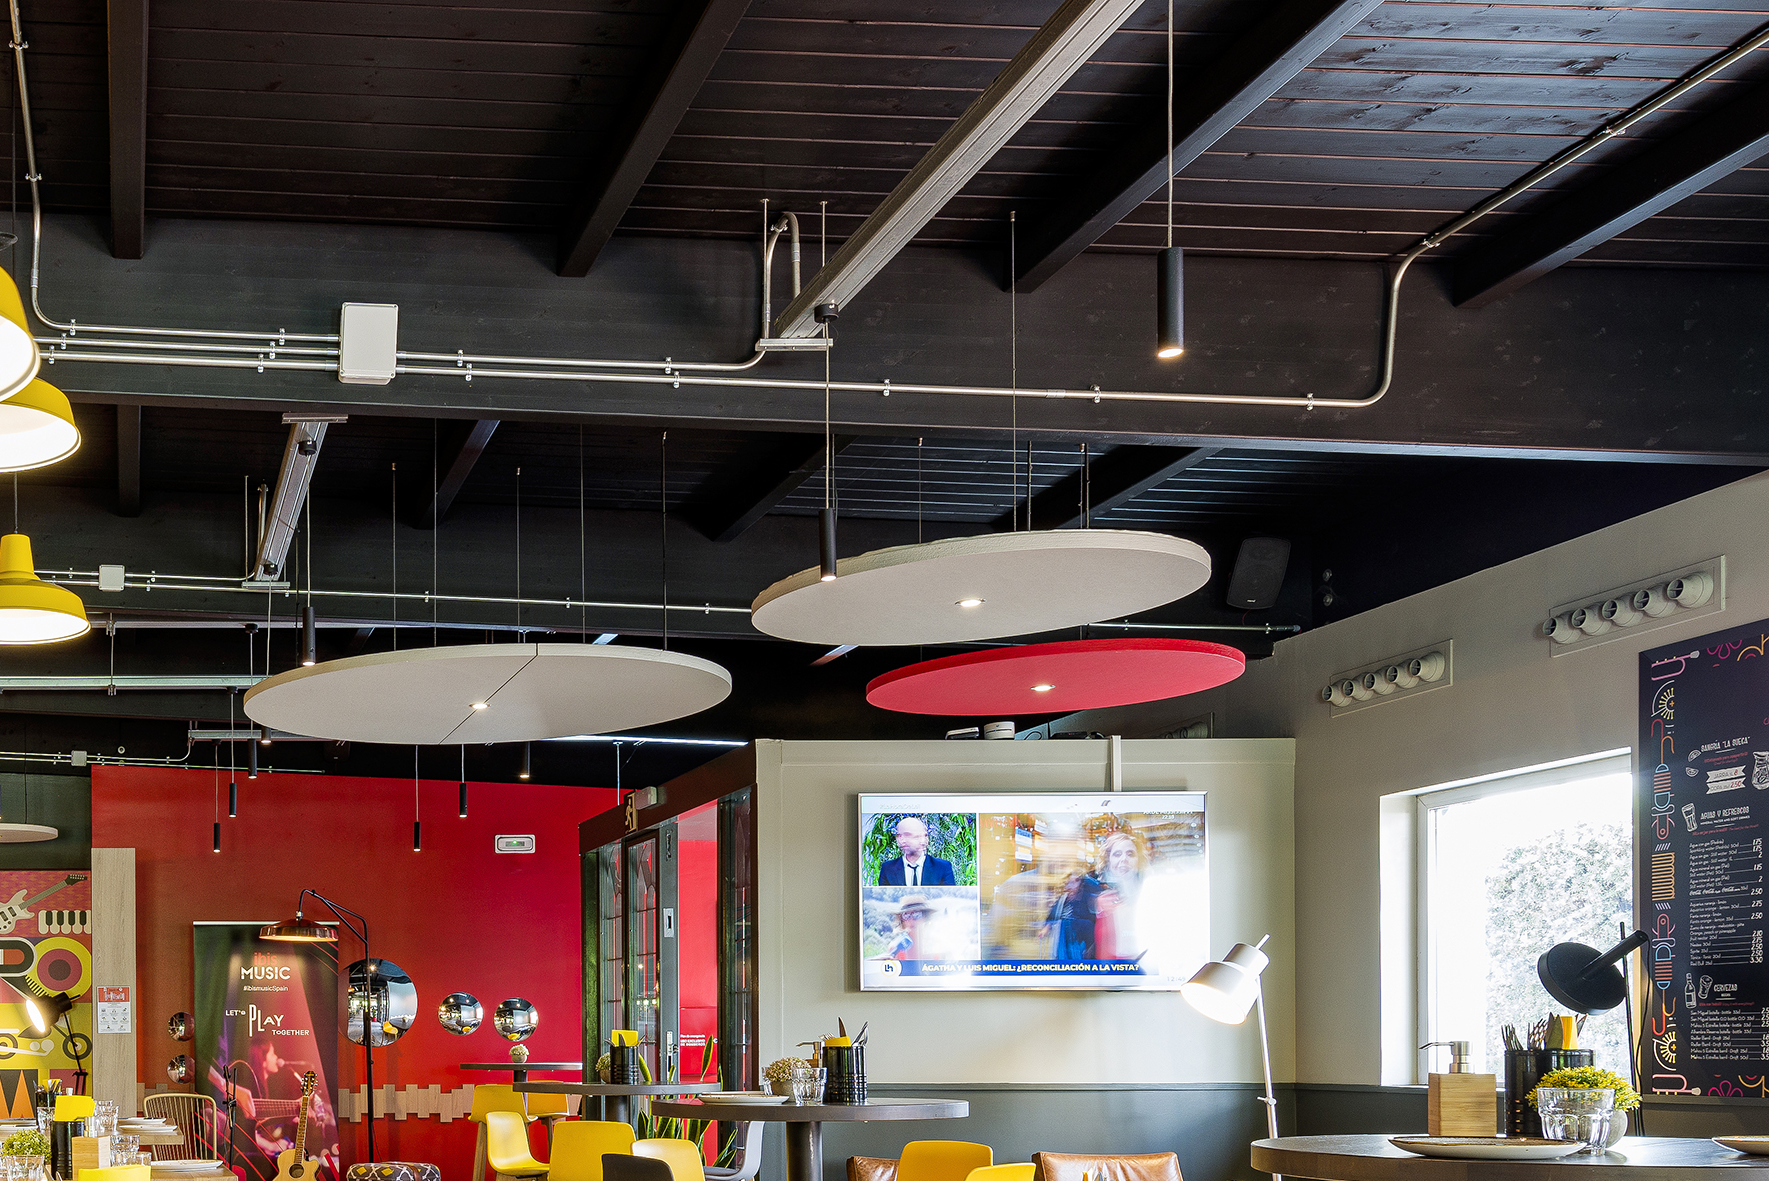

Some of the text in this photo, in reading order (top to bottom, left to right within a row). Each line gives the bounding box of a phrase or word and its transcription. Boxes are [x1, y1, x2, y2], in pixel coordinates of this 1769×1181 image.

[254, 952, 277, 965] ibis
[240, 966, 290, 980] MUSIC
[922, 962, 956, 972] ÁGATHA
[963, 964, 981, 972] LUIS
[1016, 963, 1091, 972] ¿RECONCILIACIÓN
[1714, 983, 1738, 992] CERVEZAS
[249, 1004, 285, 1037] PLAY
